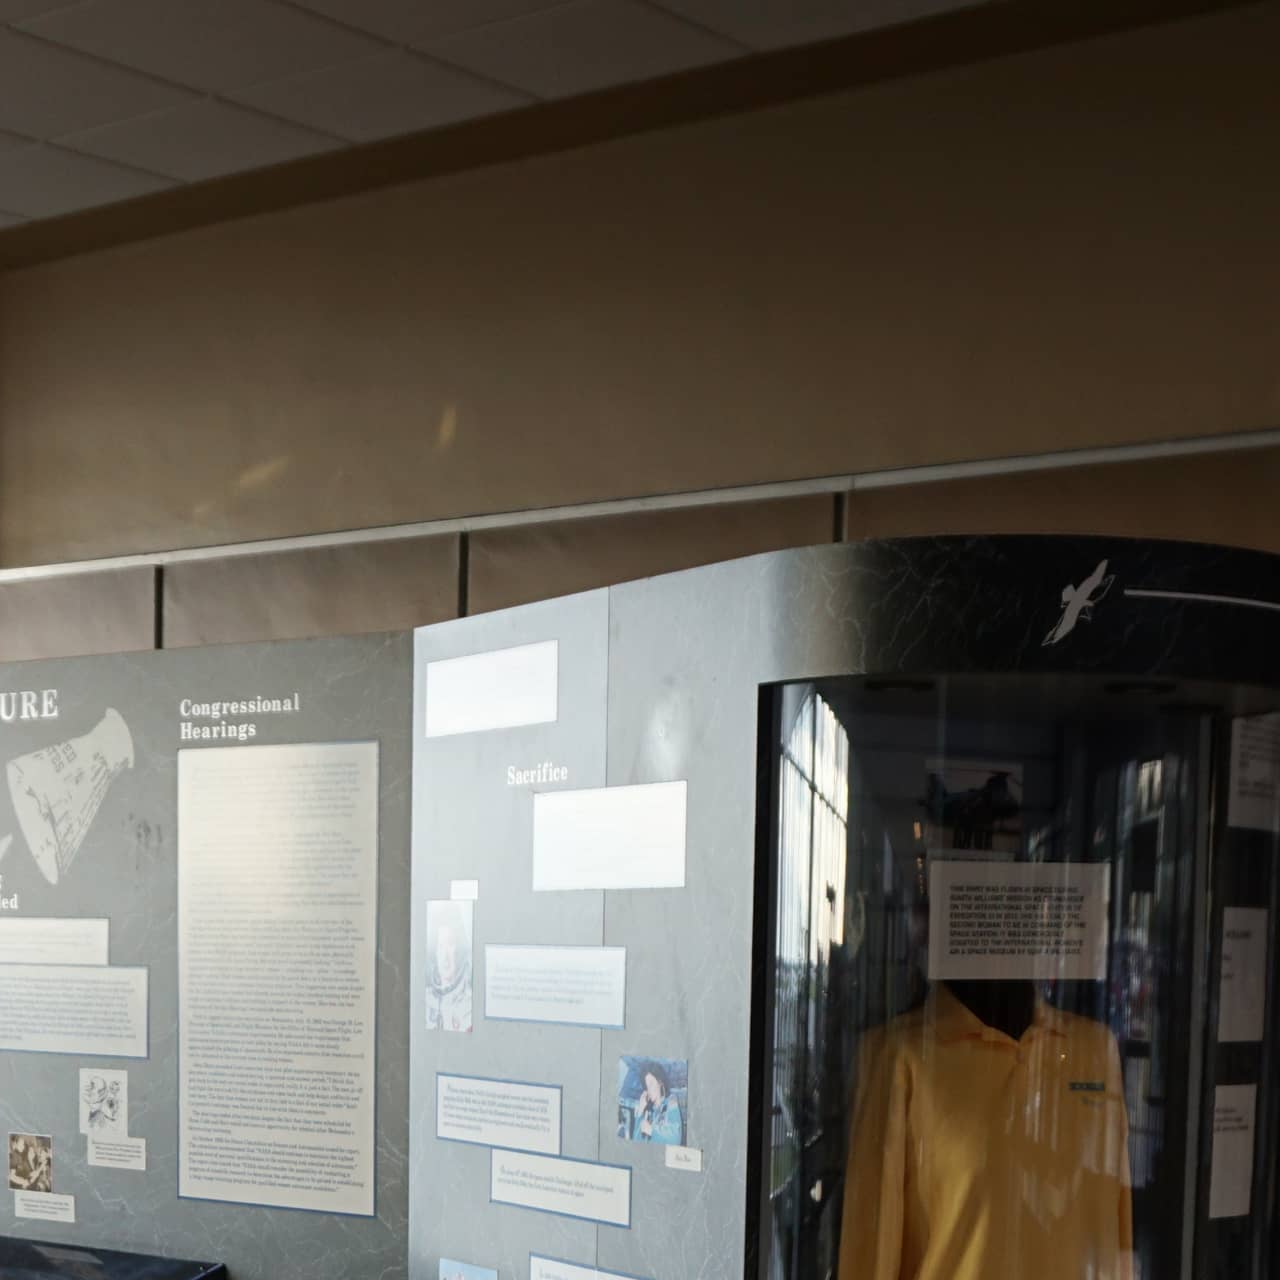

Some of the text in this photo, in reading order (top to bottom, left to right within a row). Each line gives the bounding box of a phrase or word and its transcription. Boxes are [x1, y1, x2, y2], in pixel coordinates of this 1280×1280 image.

[180, 692, 299, 718] Congressional
[180, 720, 256, 740] Hearings
[507, 761, 568, 784] Sacrifice
